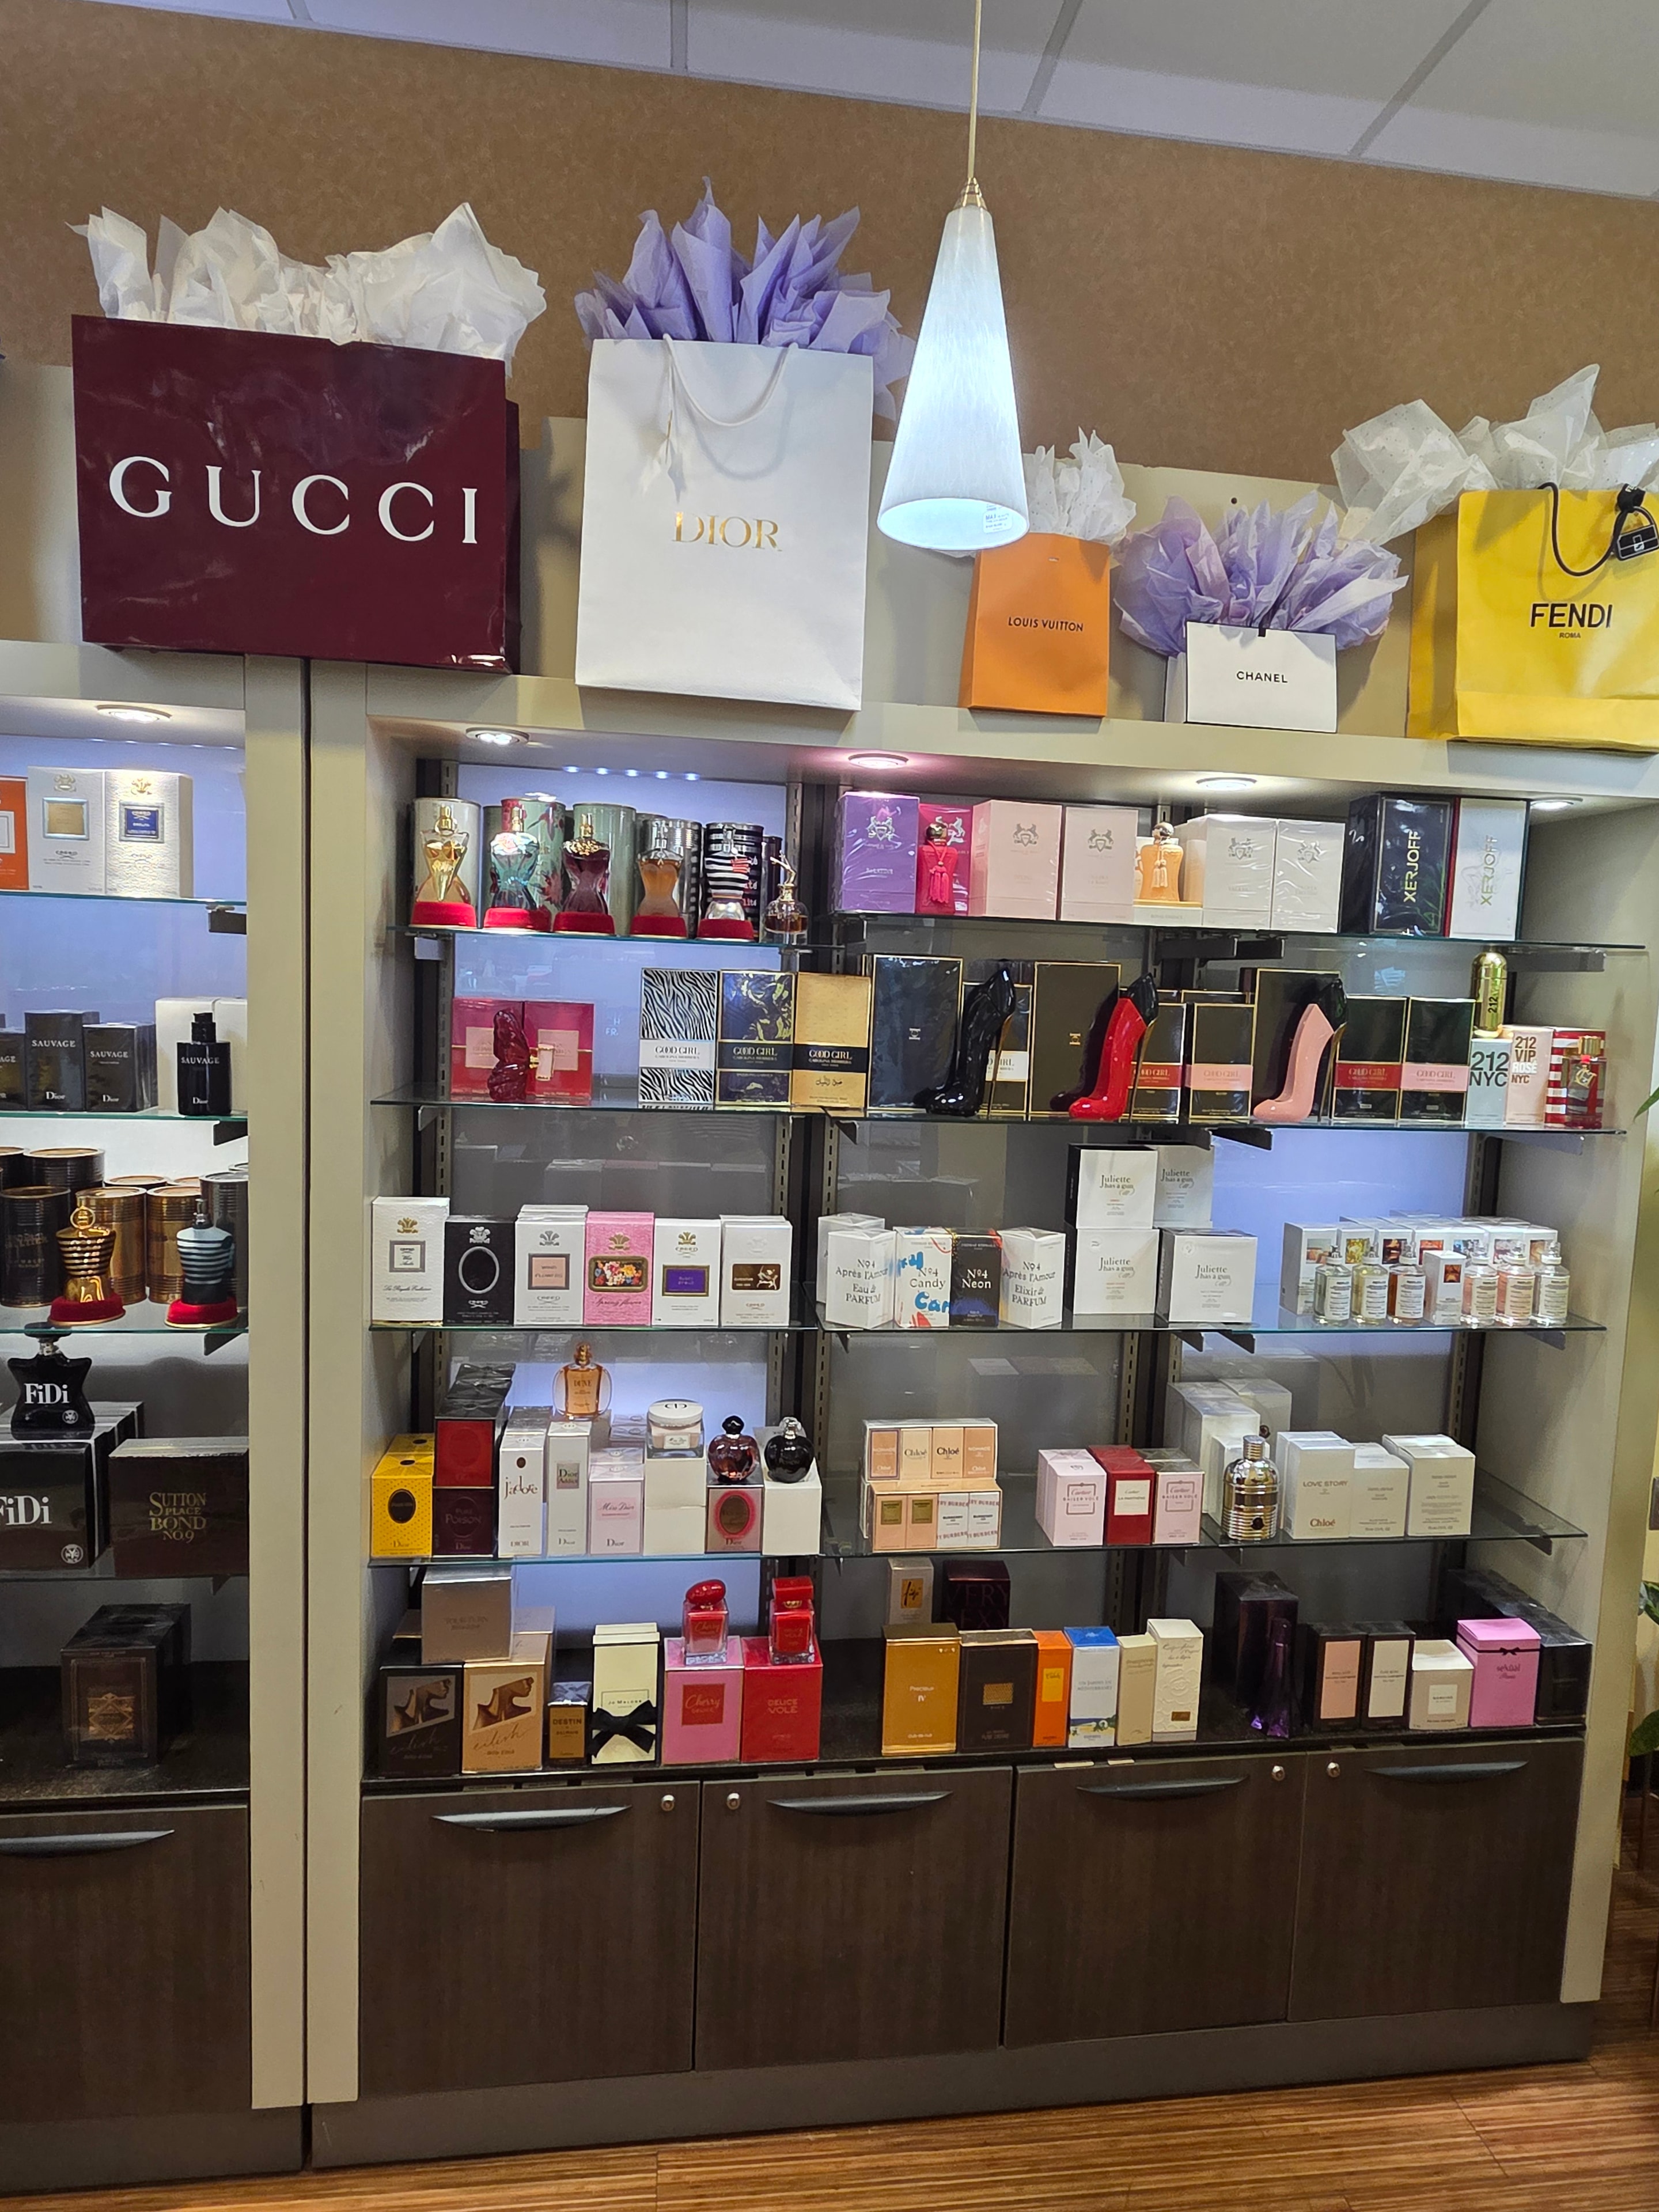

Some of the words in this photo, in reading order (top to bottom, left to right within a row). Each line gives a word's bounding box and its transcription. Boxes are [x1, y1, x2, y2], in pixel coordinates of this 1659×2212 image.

[109, 456, 478, 544] GUCCI
[671, 511, 782, 552] DIOR
[1530, 603, 1613, 630] FENDI
[1008, 616, 1039, 629] LOUIS
[1041, 619, 1084, 632] VUITTON
[1236, 671, 1289, 684] CHANEL
[1403, 830, 1424, 903] XERJOFF
[1480, 834, 1499, 906] XERJOFF
[1488, 997, 1498, 1013] 212
[1514, 1036, 1537, 1049] 212
[655, 1046, 677, 1054] GOOD
[679, 1046, 700, 1055] GIRL
[733, 1047, 755, 1055] GOOD
[756, 1047, 777, 1056] GIRL
[809, 1050, 830, 1058] GOOD
[831, 1051, 853, 1060] GIRL
[1515, 1050, 1536, 1062] VIP
[180, 1056, 219, 1065] SAUVAGE
[1470, 1051, 1510, 1071] 212
[1512, 1060, 1537, 1074] ROSÉ
[1437, 1070, 1456, 1079] GIRL
[1469, 1071, 1508, 1087] NYC
[1511, 1074, 1530, 1084] NYC
[46, 1091, 66, 1100] Dior
[192, 1096, 209, 1104] Dior
[1160, 1168, 1191, 1182] Juliette
[1100, 1175, 1131, 1188] Juliette
[1098, 1257, 1131, 1271] Juliette
[835, 1266, 862, 1278] Après
[1002, 1268, 1027, 1280] Après
[1195, 1264, 1228, 1279] Juliette
[853, 1283, 869, 1294] Eau
[910, 1278, 946, 1290] Candy
[961, 1278, 991, 1289] Neon
[1014, 1285, 1037, 1297] Elixir
[1012, 1295, 1047, 1307] PARFUM
[24, 1383, 70, 1404] FiDi
[936, 1446, 960, 1455] Chloé
[559, 1469, 578, 1478] Dior
[1071, 1488, 1092, 1496] Cartier
[149, 1492, 207, 1517] SUTTON
[165, 1507, 202, 1515] PLACE
[150, 1516, 207, 1531] BOND
[1309, 1518, 1336, 1527] Chloé
[607, 1539, 624, 1547] Dior
[946, 1584, 1009, 1607] VERY
[684, 1694, 721, 1709] Cherry
